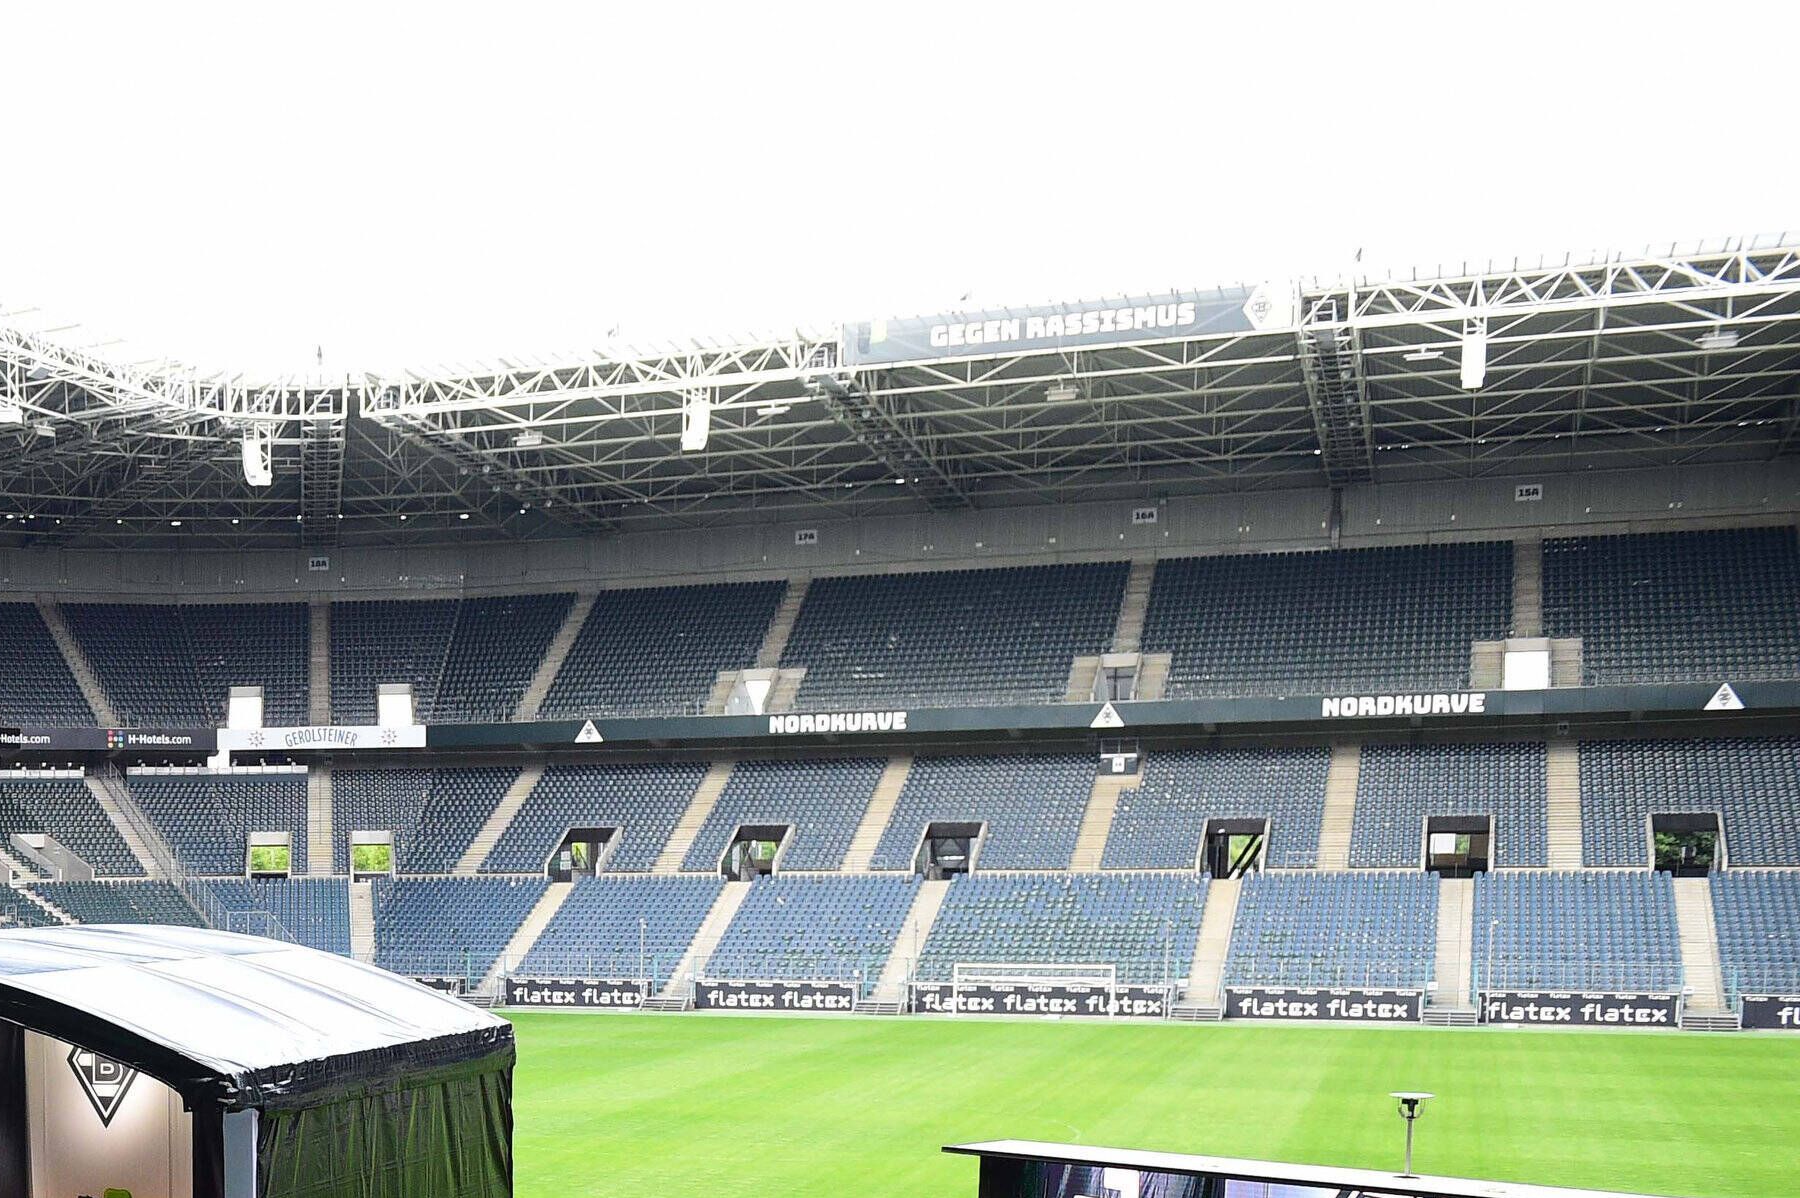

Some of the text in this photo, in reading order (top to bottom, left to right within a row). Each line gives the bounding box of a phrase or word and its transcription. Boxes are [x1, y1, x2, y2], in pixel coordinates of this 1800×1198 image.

[930, 302, 1196, 347] GEGEN RASSISMUS
[1321, 693, 1485, 718] NORDKURVE
[769, 712, 907, 734] NORDKURVE
[128, 734, 192, 746] H-Hotels.com
[284, 727, 358, 747] GEROLSTEINER
[513, 987, 576, 1004] flatex
[707, 990, 851, 1008] flatex flatex
[922, 993, 1162, 1014] flatex flatex flatex
[1238, 998, 1409, 1018] flatex flatex
[1487, 1002, 1668, 1023] flatex flatex
